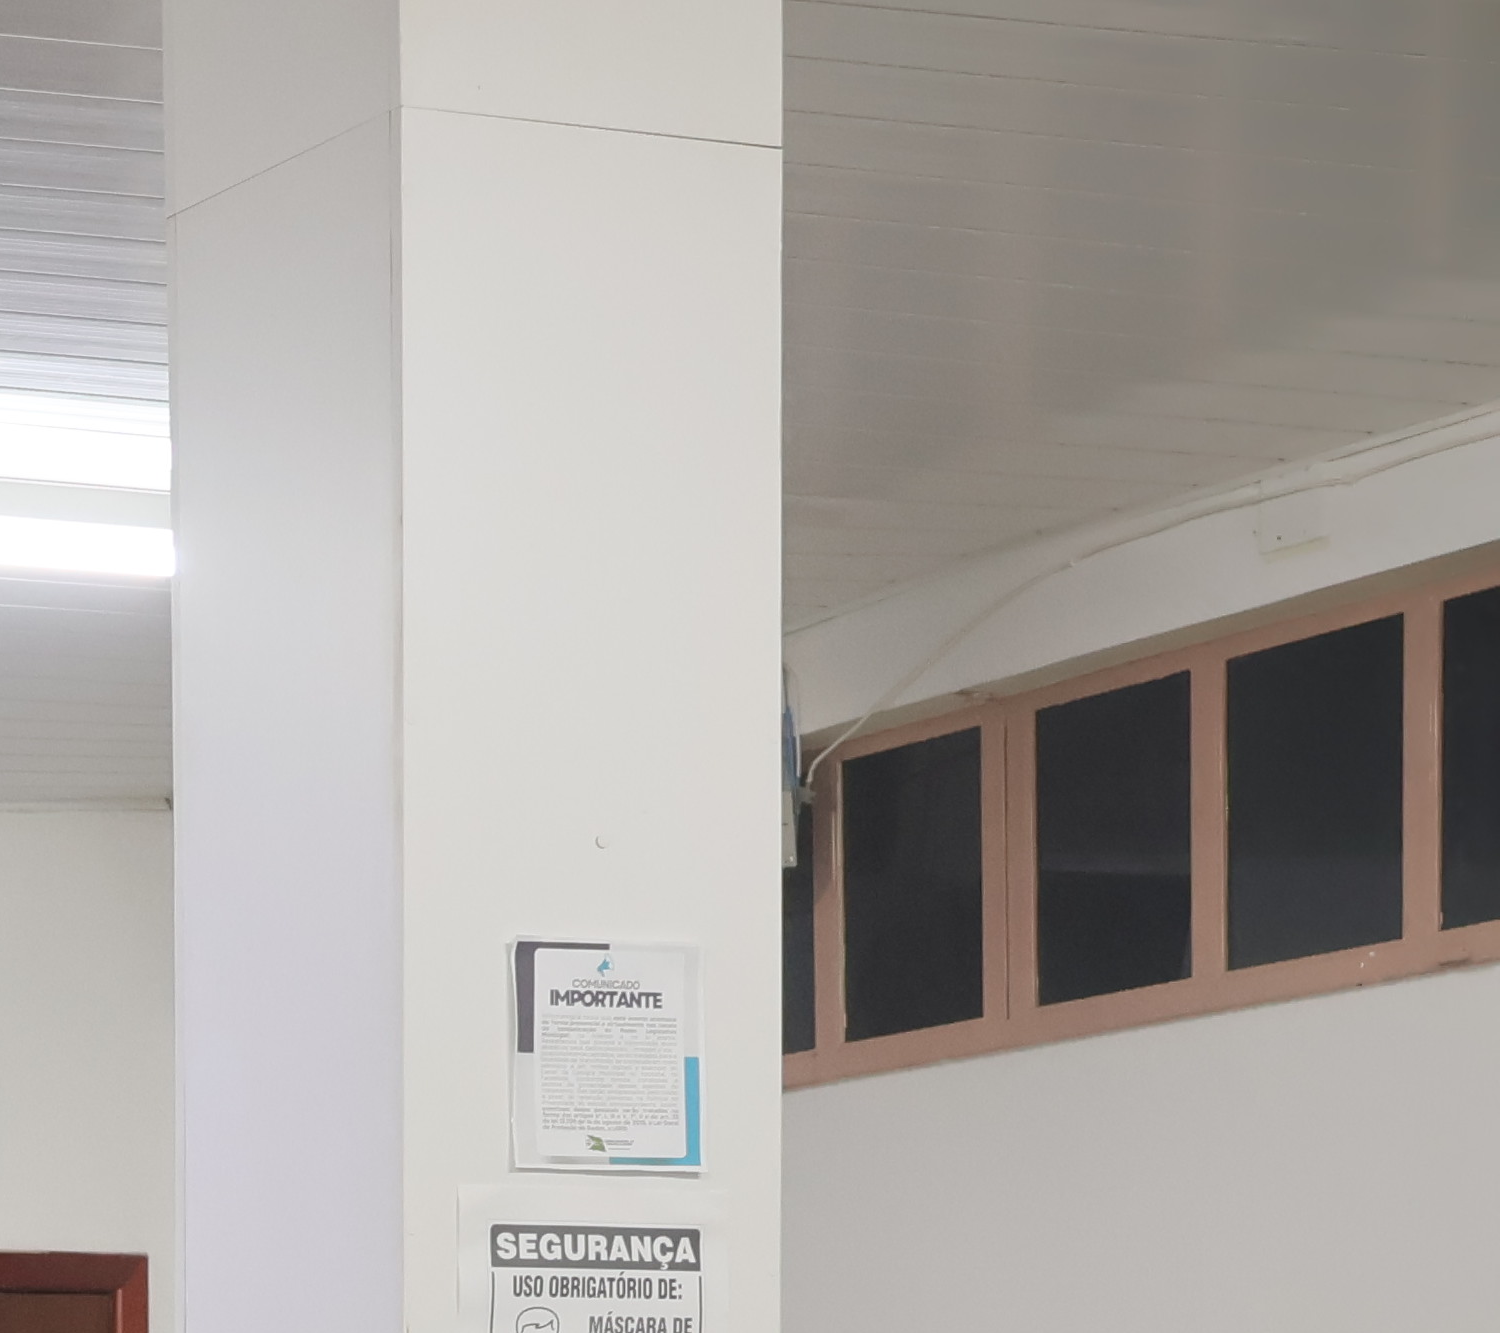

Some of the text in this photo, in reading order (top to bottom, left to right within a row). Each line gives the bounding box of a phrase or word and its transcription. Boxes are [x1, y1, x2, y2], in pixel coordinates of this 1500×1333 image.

[572, 978, 640, 990] COMUNICADO
[550, 989, 663, 1009] IMPORTANTE
[496, 1232, 696, 1270] SEGURANÇA
[513, 1272, 682, 1300] USO OBRIGATÓRIO DE:
